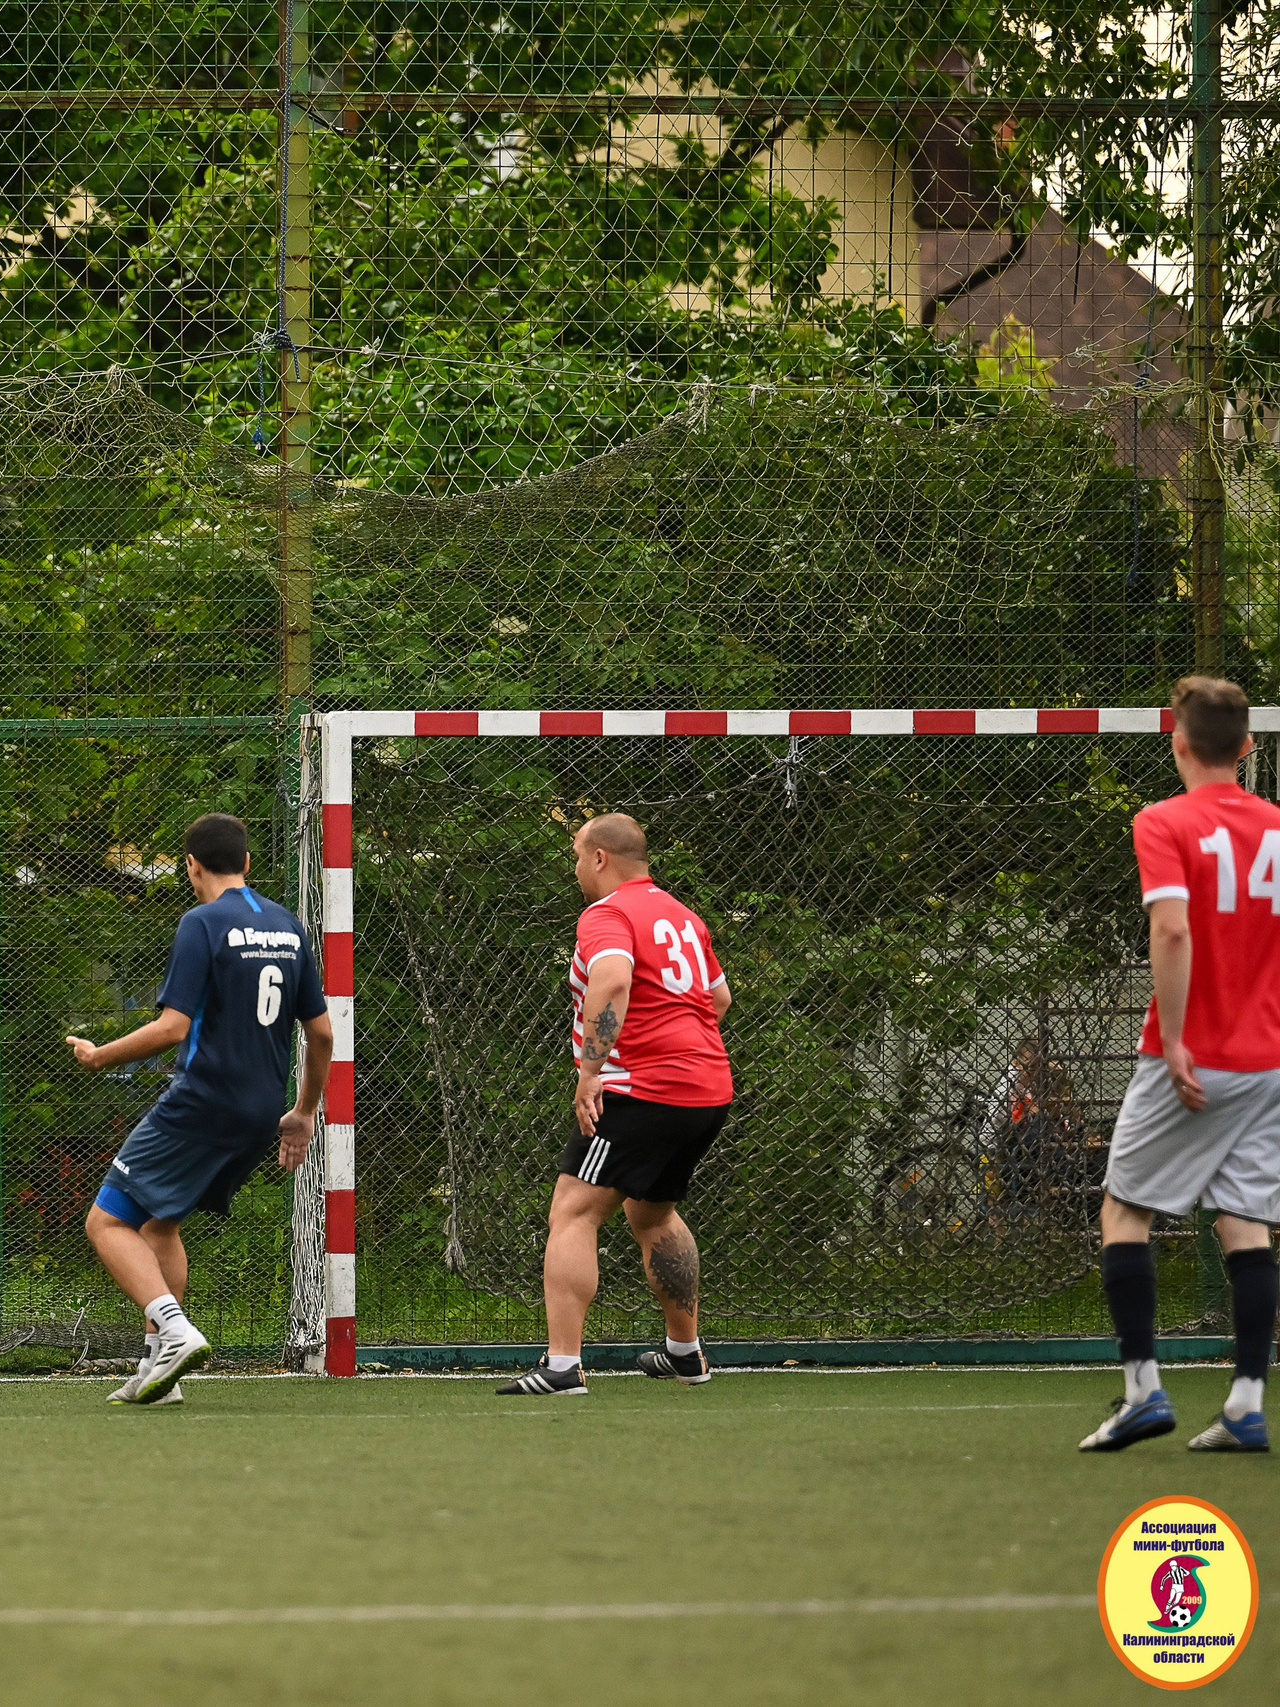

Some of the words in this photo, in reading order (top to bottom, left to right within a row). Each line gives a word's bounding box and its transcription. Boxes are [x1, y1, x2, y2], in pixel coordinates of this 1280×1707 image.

[1199, 827, 1280, 916] 14
[653, 918, 710, 995] 31
[257, 965, 284, 1027] 6
